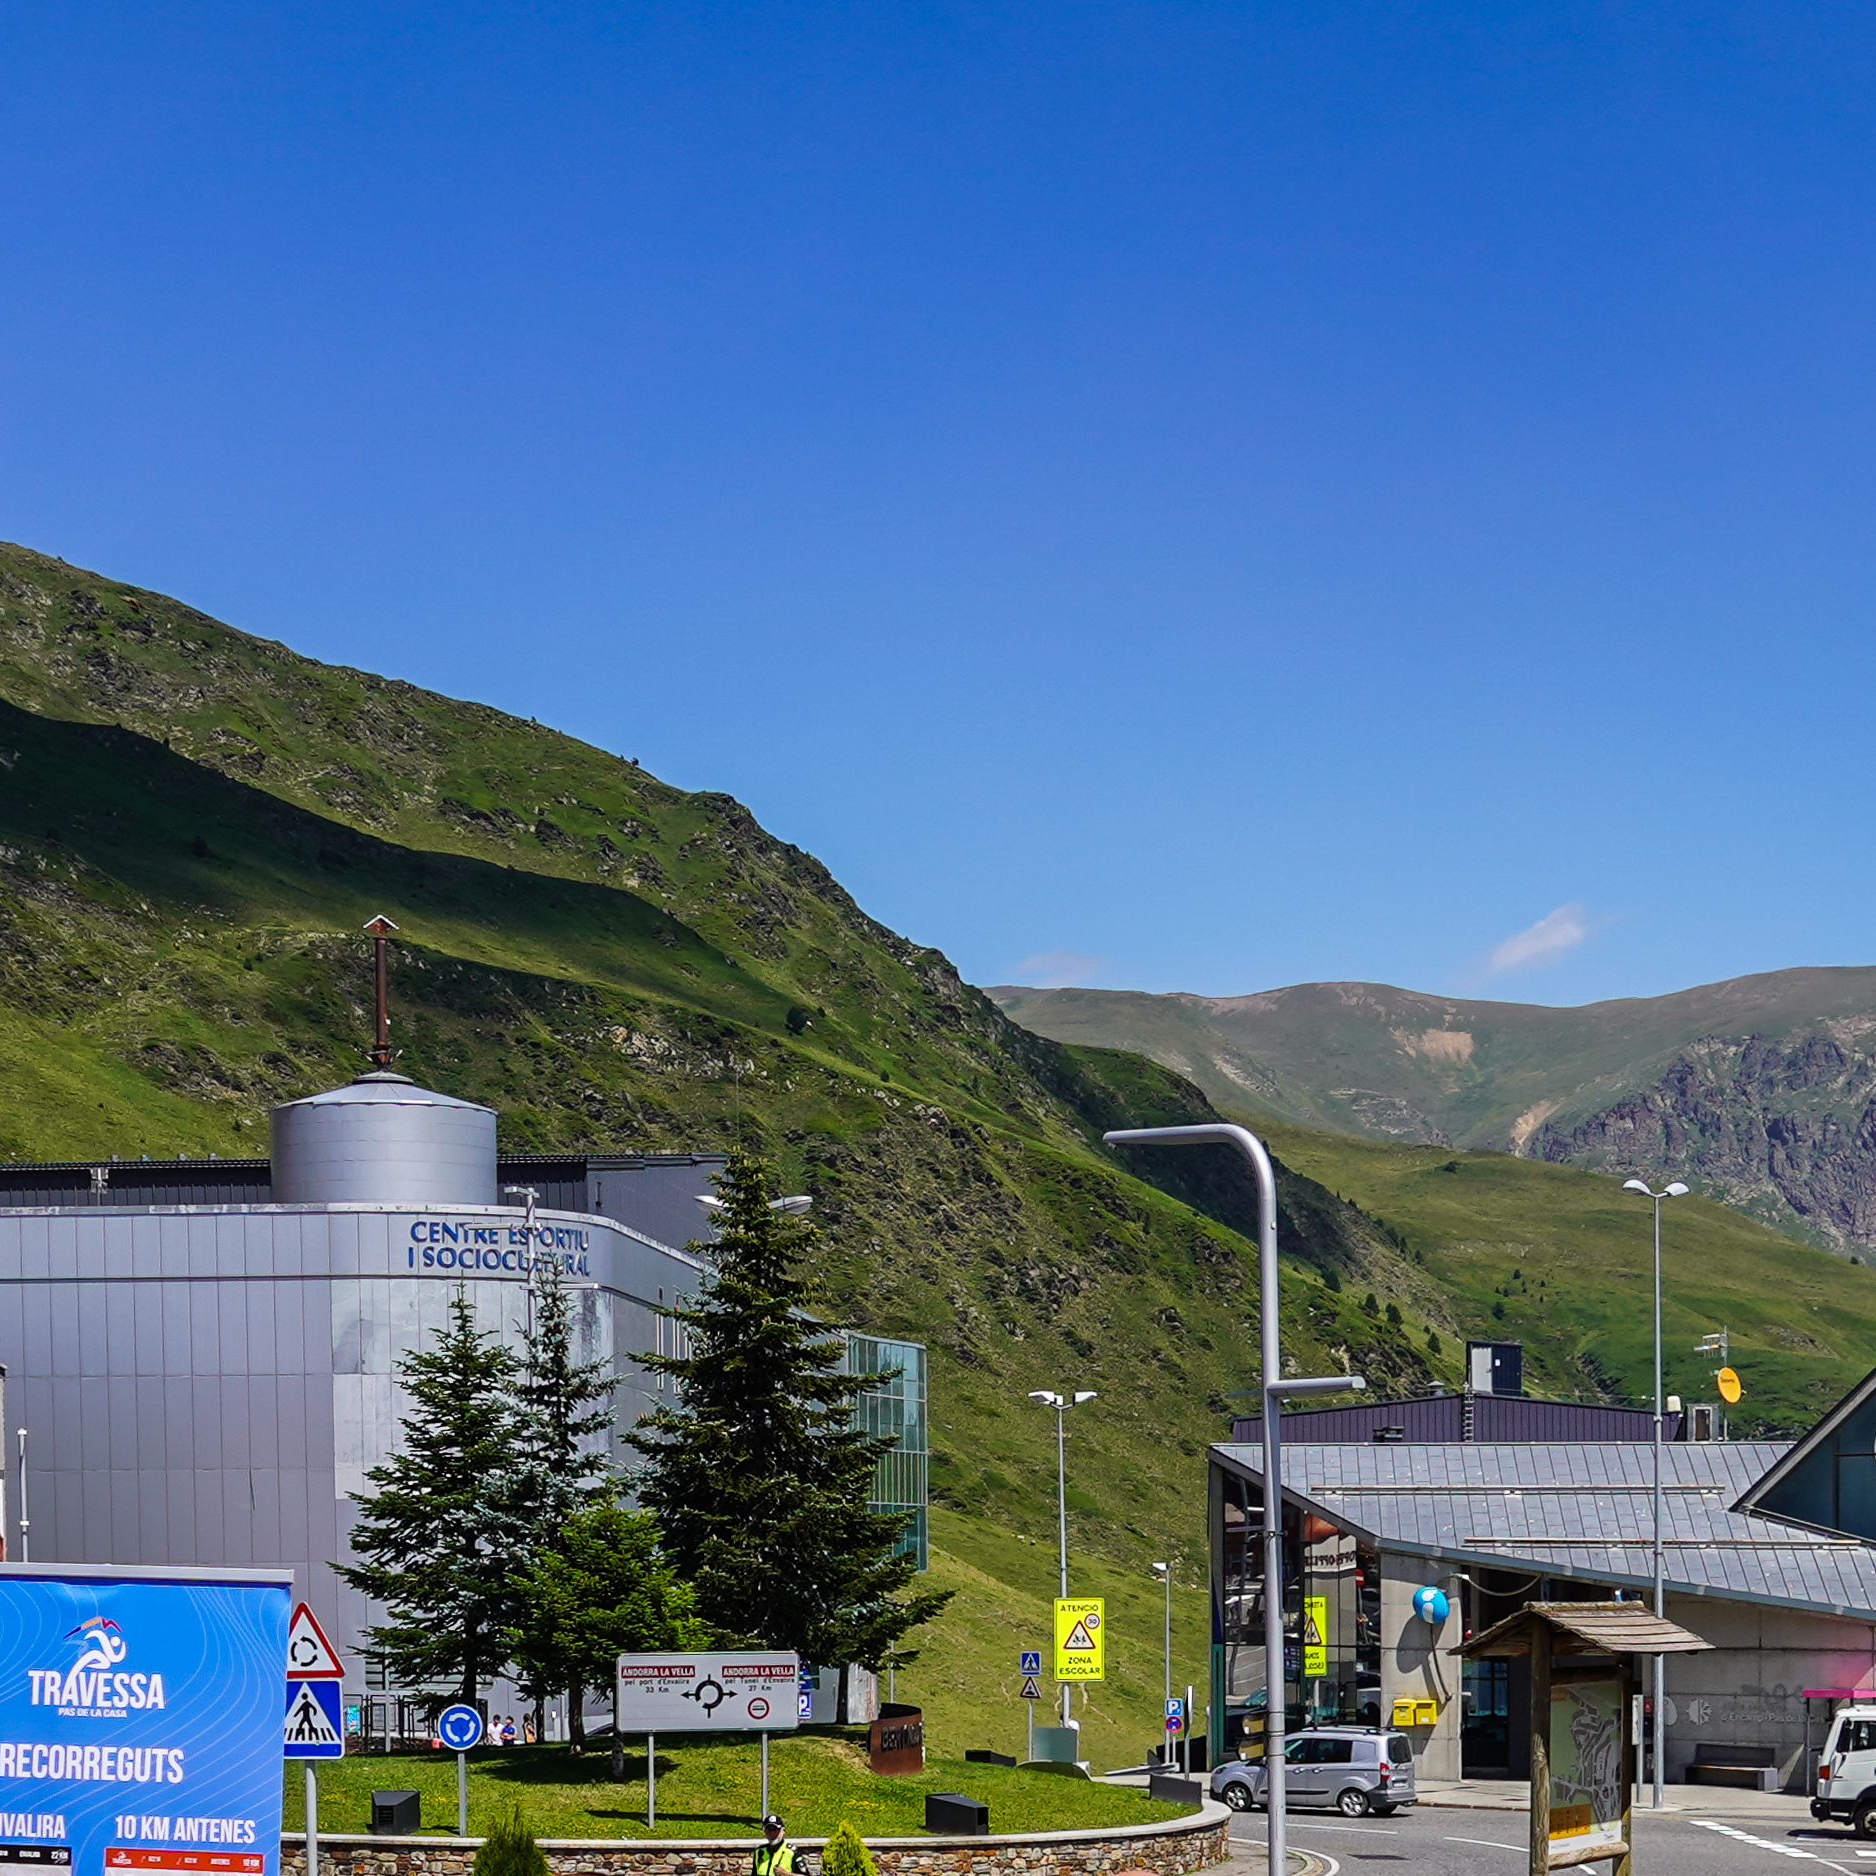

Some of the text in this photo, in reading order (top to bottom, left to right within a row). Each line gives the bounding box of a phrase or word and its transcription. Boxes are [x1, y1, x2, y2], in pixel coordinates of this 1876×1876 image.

[408, 1246, 414, 1268] I
[1067, 1656, 1093, 1665] ZONA
[623, 1667, 695, 1676] ANDORRA LA VELLA
[723, 1667, 795, 1676] ANDORRA LA VELLA
[1059, 1667, 1101, 1675] ESCOLAR
[27, 1670, 166, 1709] TRAVESSA
[59, 1707, 127, 1718] PAS DE LA CASA
[115, 1815, 256, 1844] 10 KM ANTENES
